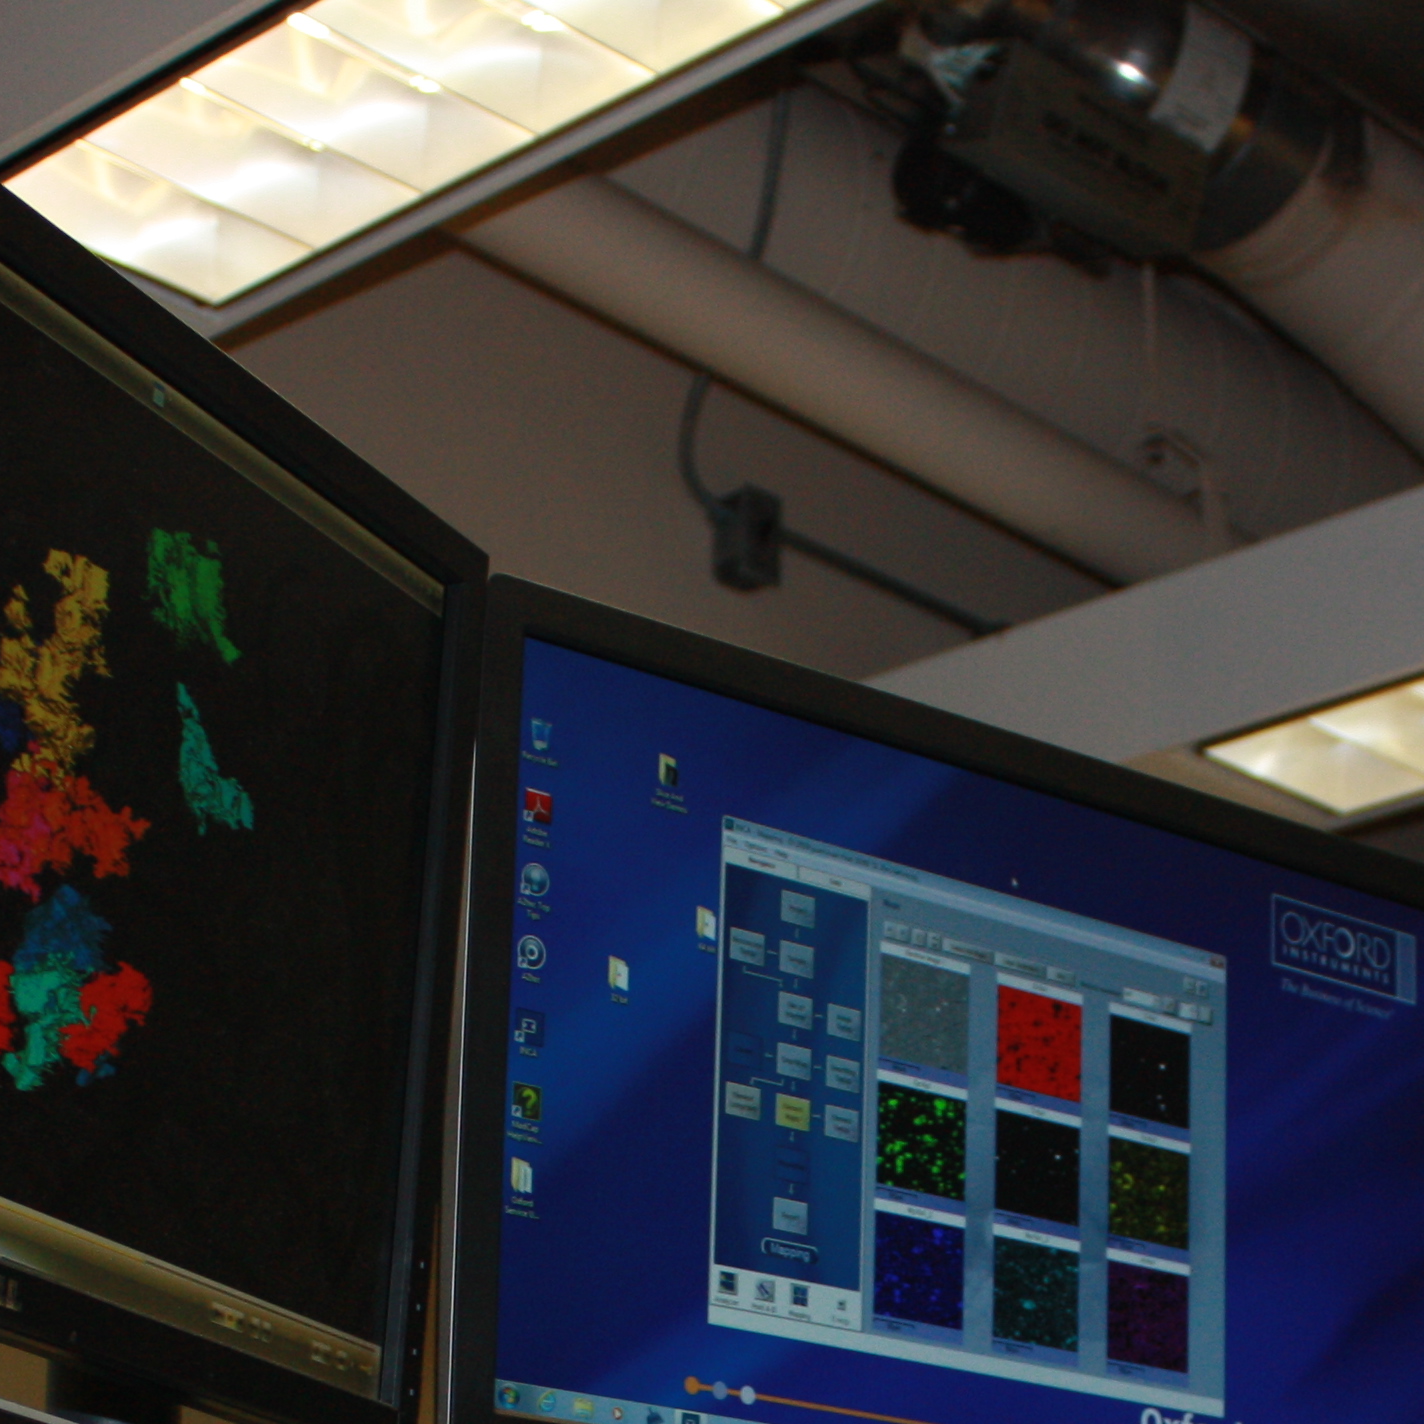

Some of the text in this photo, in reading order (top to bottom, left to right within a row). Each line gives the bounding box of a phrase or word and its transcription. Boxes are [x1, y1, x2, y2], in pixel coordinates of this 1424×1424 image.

[1280, 911, 1392, 970] OXFORD
[1282, 945, 1390, 984] INSTRUMENTS
[770, 1242, 811, 1263] Mapping
